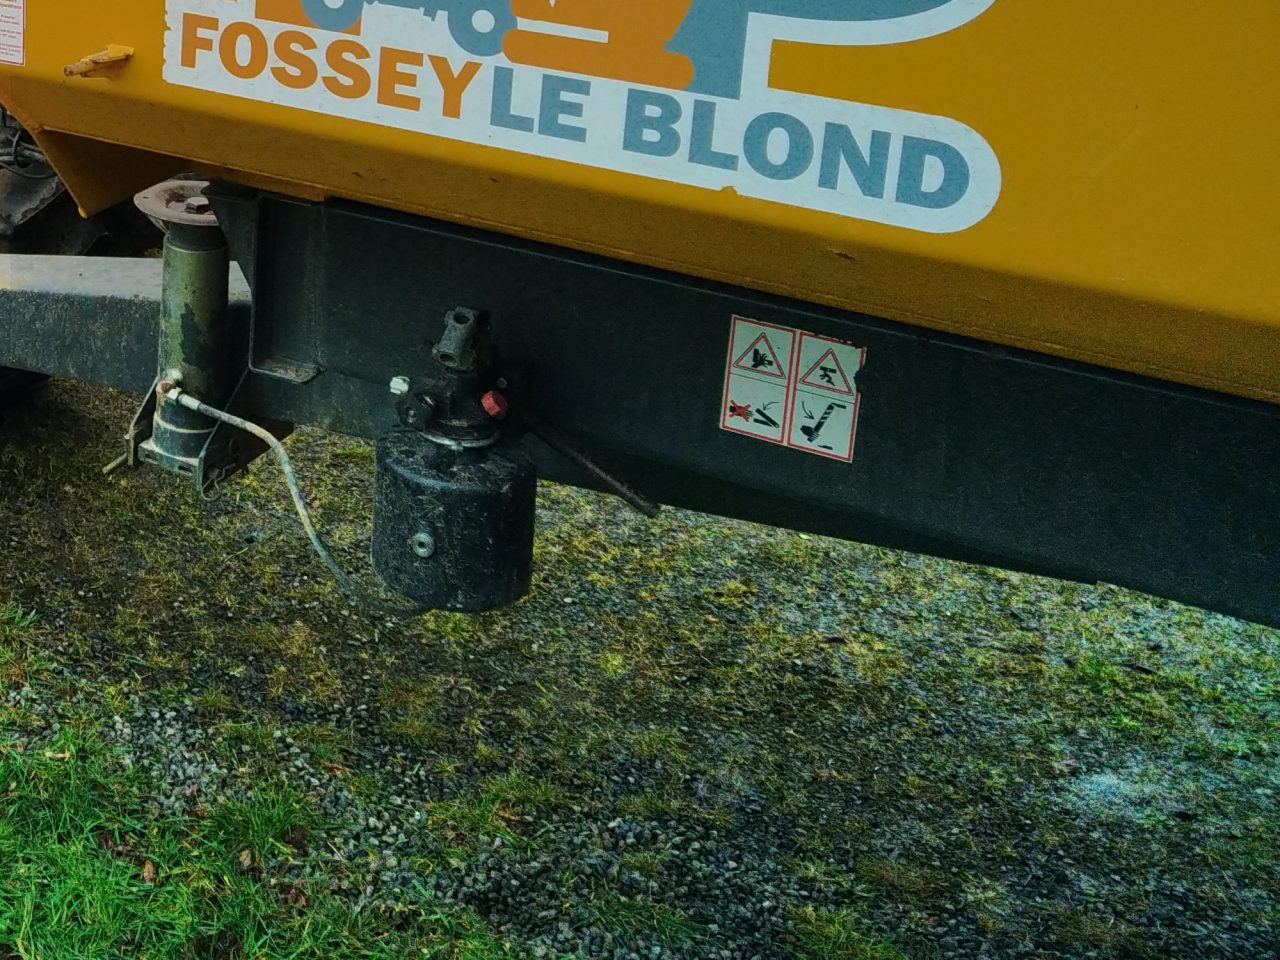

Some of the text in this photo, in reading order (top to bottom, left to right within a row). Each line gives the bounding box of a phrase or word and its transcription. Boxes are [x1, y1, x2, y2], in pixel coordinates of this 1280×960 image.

[180, 12, 971, 209] FOSSEY LE BLOND
